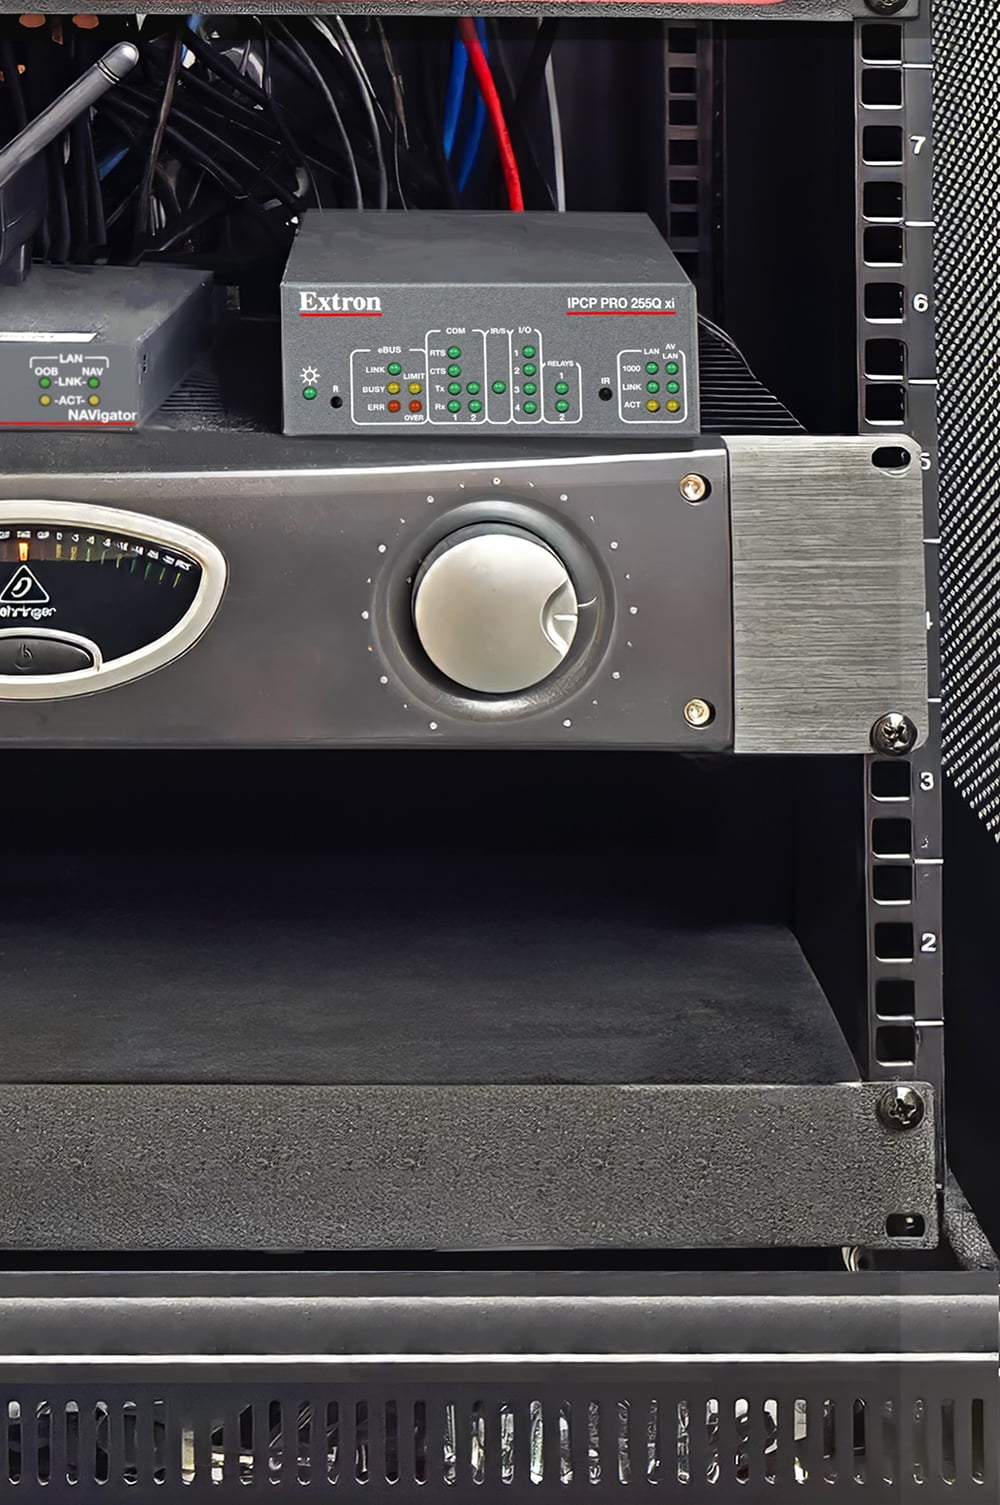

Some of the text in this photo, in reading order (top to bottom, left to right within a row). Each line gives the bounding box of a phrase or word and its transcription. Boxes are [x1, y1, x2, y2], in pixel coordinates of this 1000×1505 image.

[909, 135, 927, 155] 7
[299, 291, 382, 311] Extron
[567, 297, 676, 310] IPCP PRO 255Q xi
[911, 292, 930, 314] 6
[445, 327, 466, 335] COM
[490, 327, 507, 335] IR/S
[518, 326, 532, 334] I/O
[377, 346, 402, 354] eBUS
[429, 349, 446, 357] RTS
[59, 353, 83, 364] LAN
[662, 352, 679, 360] LAN
[34, 367, 59, 376] OOB
[81, 367, 104, 376] NAV
[365, 366, 385, 374] LINK
[429, 367, 446, 375] CTS
[403, 372, 426, 380] LIMIT
[601, 377, 611, 385] IR
[333, 385, 339, 393] R
[362, 385, 385, 393] BUSY
[367, 403, 385, 411] ERR
[514, 404, 521, 412] 4
[68, 409, 137, 423] NAVigator
[404, 414, 424, 422] OVER
[919, 451, 933, 471] 5
[918, 771, 935, 791] 3
[920, 932, 937, 952] 2
